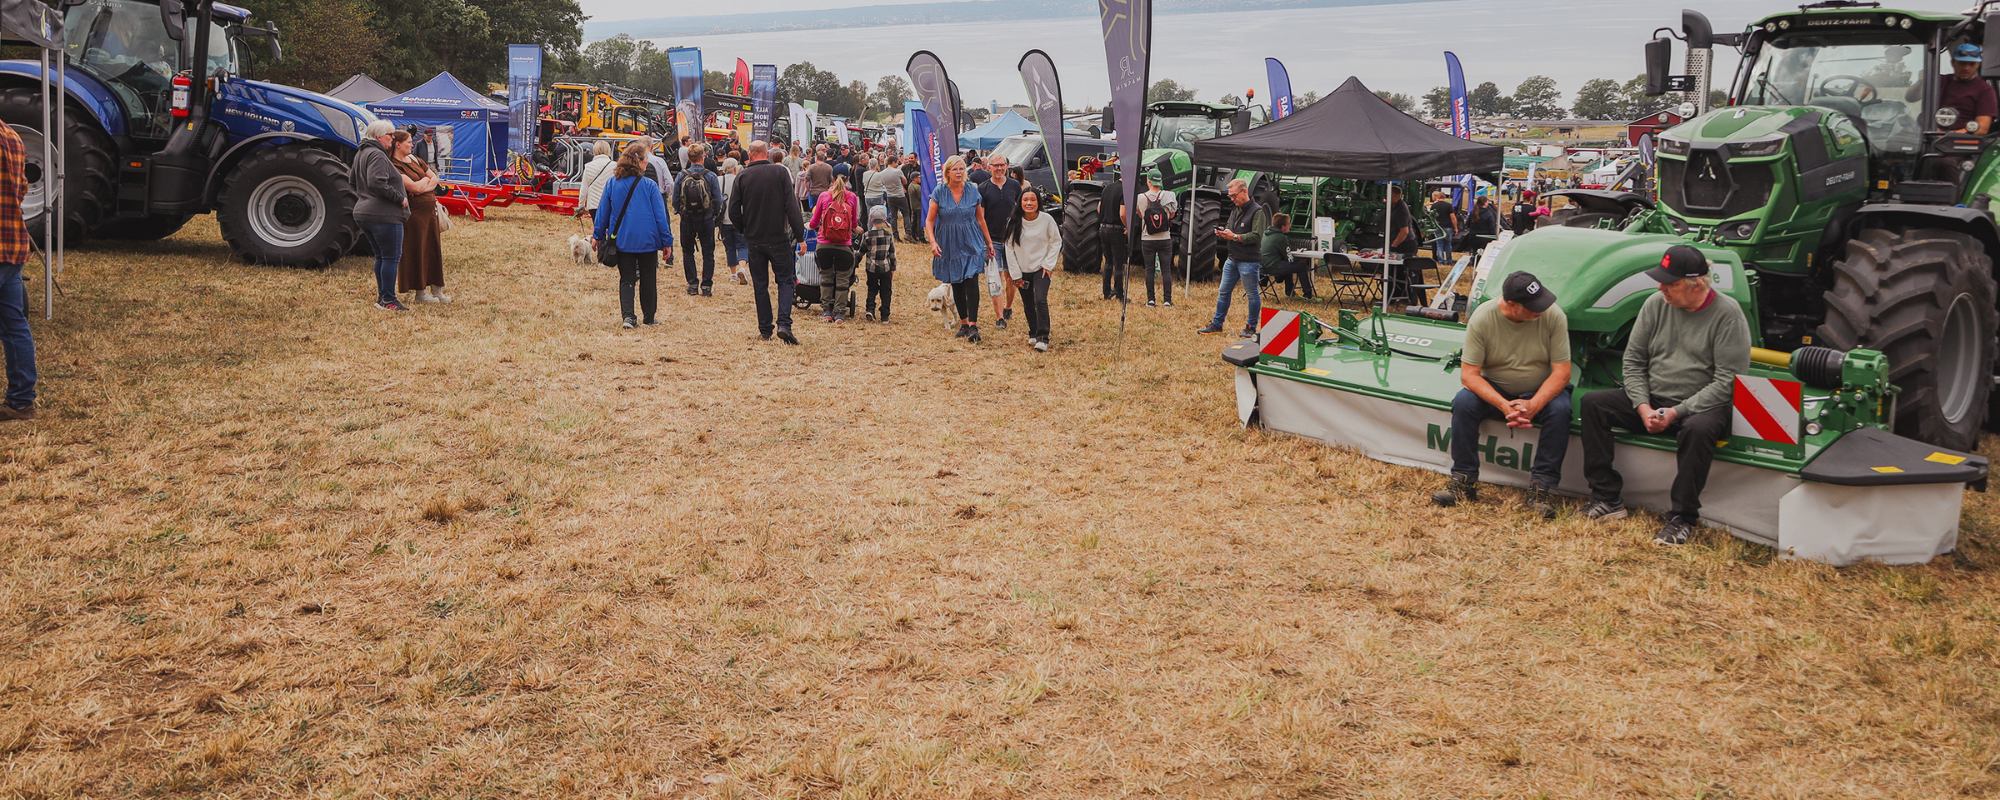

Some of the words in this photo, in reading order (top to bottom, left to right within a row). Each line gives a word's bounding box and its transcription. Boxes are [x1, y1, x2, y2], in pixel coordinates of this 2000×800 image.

[718, 101, 739, 109] VOLVO
[225, 108, 243, 116] NEW
[244, 112, 280, 127] HOLLAND
[1825, 171, 1855, 186] DEUTZ-FAHR
[1427, 423, 1534, 472] MHal
